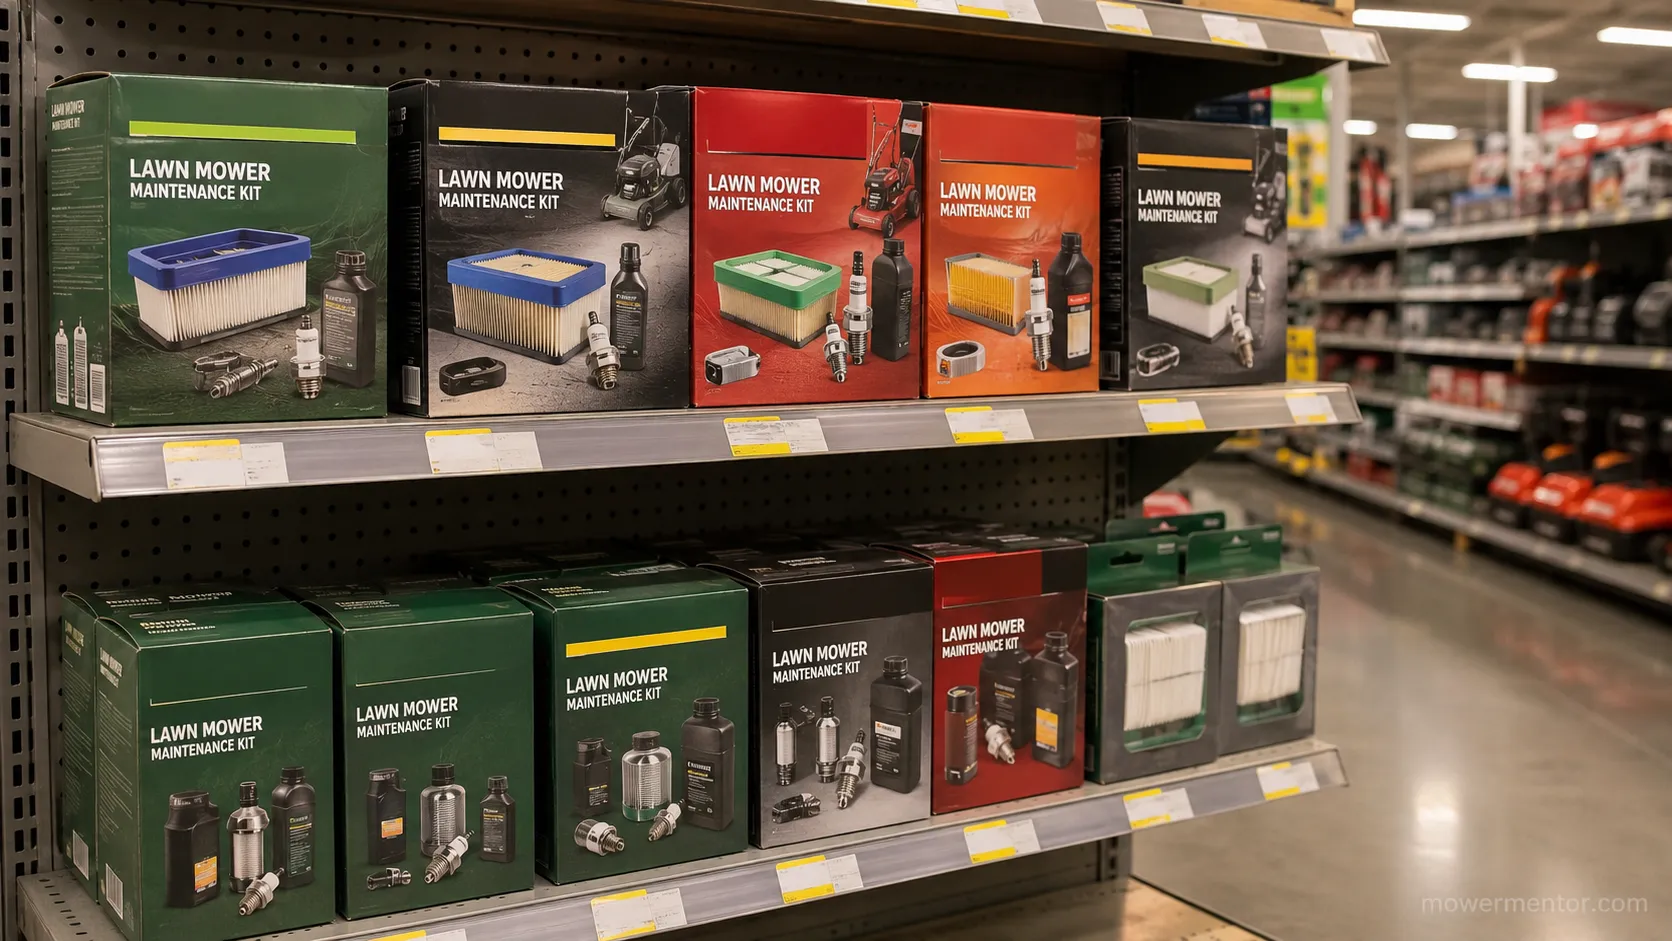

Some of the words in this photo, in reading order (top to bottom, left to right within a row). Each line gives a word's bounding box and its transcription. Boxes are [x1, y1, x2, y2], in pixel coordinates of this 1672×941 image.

[130, 158, 189, 179] LAWN
[196, 161, 270, 181] MOWER
[438, 169, 490, 188] LAWN
[497, 171, 564, 190] MOWER
[130, 182, 236, 200] MAINTENANCE
[240, 185, 262, 200] KIT
[708, 174, 755, 192] LAWN
[760, 176, 820, 195] MOWER
[940, 182, 981, 200] LAWN
[986, 184, 1036, 202] MOWER
[439, 192, 536, 209] MAINTENANCE
[539, 194, 560, 209] KIT
[708, 196, 794, 212] MAINTENANCE
[796, 198, 814, 212] KIT
[1138, 188, 1174, 206] LAWN
[1176, 190, 1221, 207] MOWER
[940, 203, 1013, 218] MAINTENANCE
[1016, 206, 1032, 218] KIT
[1138, 208, 1202, 223] MAINTENANCE
[1204, 210, 1218, 223] KIT
[942, 624, 977, 642] LAWN
[980, 618, 1025, 638] MOWER
[773, 647, 812, 667] LAWN
[816, 640, 868, 662] MOWER
[942, 638, 1004, 658] MAINTENANCE
[1006, 636, 1020, 650] KIT
[566, 674, 609, 694] LAWN
[614, 666, 668, 688] MOWER
[773, 664, 842, 684] MAINTENANCE
[845, 660, 860, 674] KIT
[356, 703, 399, 722] LAWN
[404, 696, 458, 716] MOWER
[566, 689, 642, 711] MAINTENANCE
[646, 686, 662, 700] KIT
[150, 723, 198, 744] LAWN
[202, 716, 262, 738] MOWER
[357, 718, 432, 738] MAINTENANCE
[436, 716, 451, 728] KIT
[151, 738, 234, 760] MAINTENANCE
[238, 736, 256, 750] KIT
